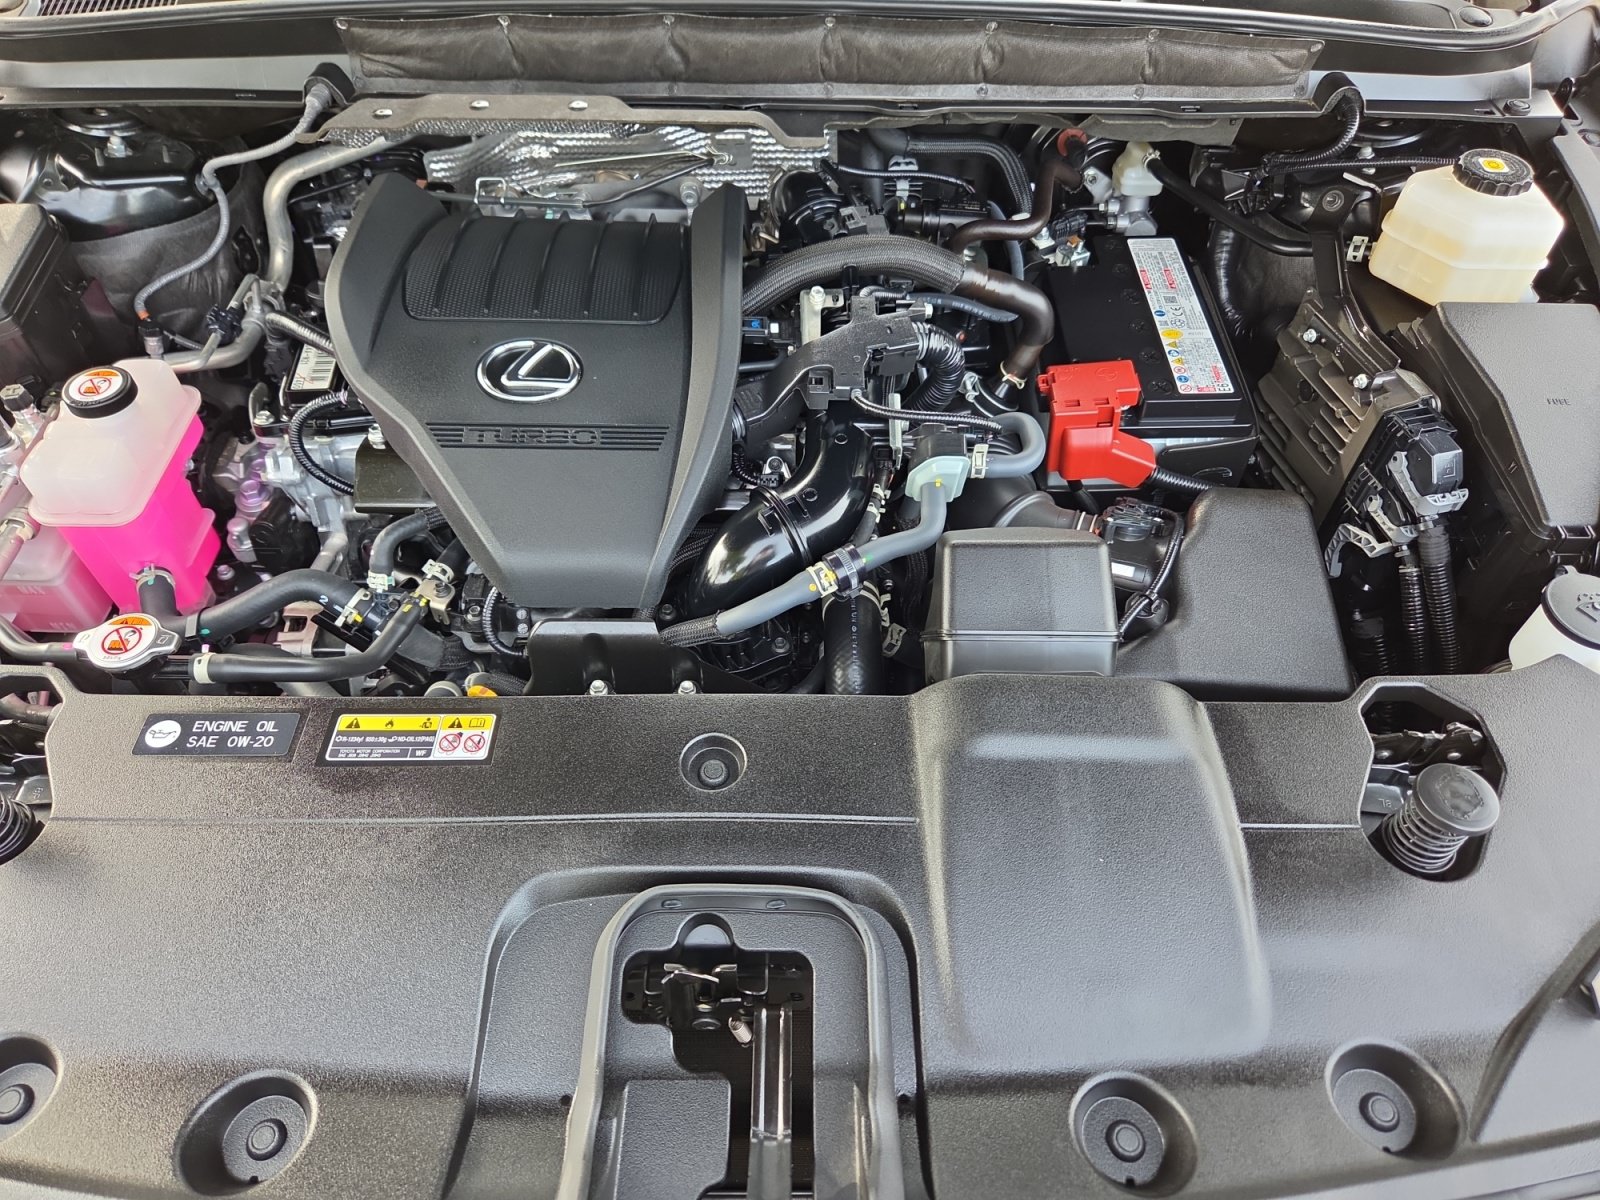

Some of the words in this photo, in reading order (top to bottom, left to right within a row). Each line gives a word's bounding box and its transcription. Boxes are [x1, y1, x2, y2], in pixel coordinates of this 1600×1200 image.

[464, 427, 598, 445] TURBO
[192, 720, 248, 732] ENGINE
[256, 721, 279, 732] OIL
[186, 735, 219, 748] SAE
[227, 735, 274, 748] 0W-20
